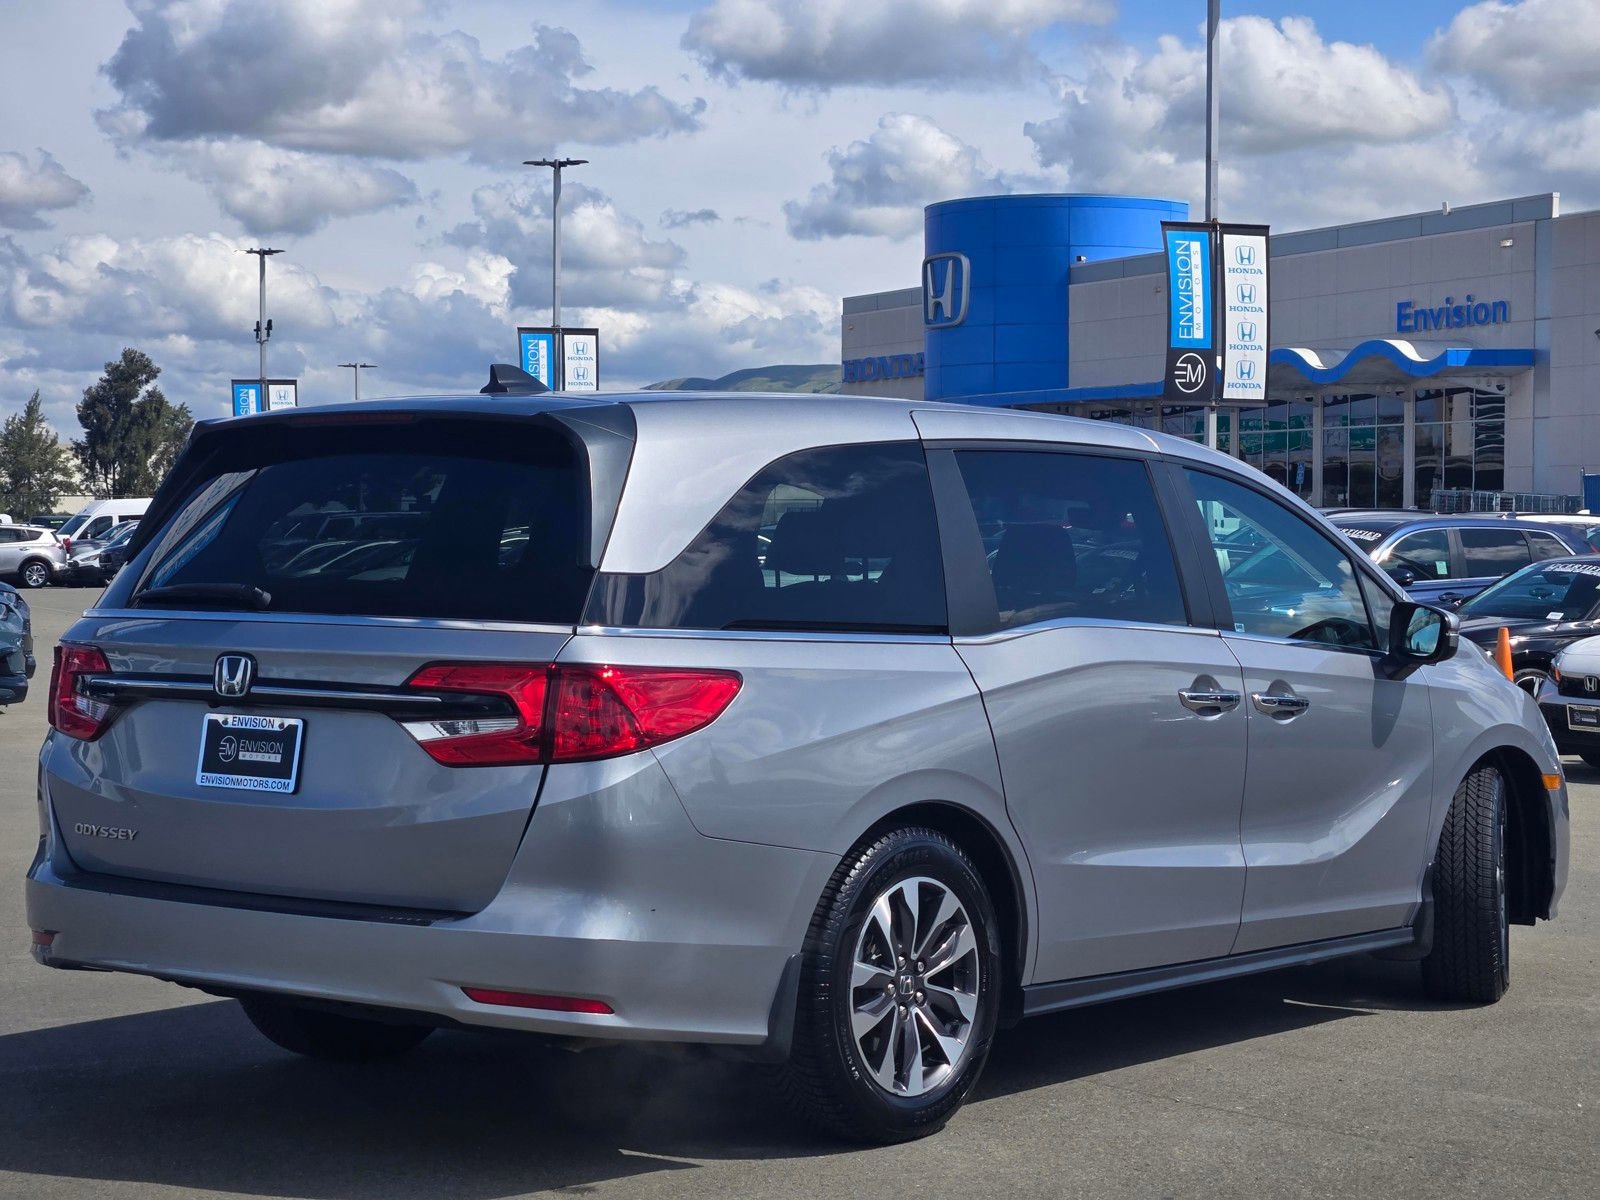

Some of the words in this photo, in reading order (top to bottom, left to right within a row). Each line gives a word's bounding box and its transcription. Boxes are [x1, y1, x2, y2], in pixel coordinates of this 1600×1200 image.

[1227, 266, 1263, 275] HONDA
[1175, 240, 1193, 339] ENVISION
[1193, 250, 1202, 331] MOTORS
[1229, 305, 1264, 313] HONDA
[1396, 294, 1508, 333] Envision
[1229, 343, 1263, 352] HONDA
[1227, 381, 1263, 390] HONDA
[231, 716, 275, 729] ENVISION
[239, 739, 284, 754] ENVISION
[200, 775, 290, 791] ENVISIONMOTORS.COM
[74, 822, 138, 841] ODYSSEY
